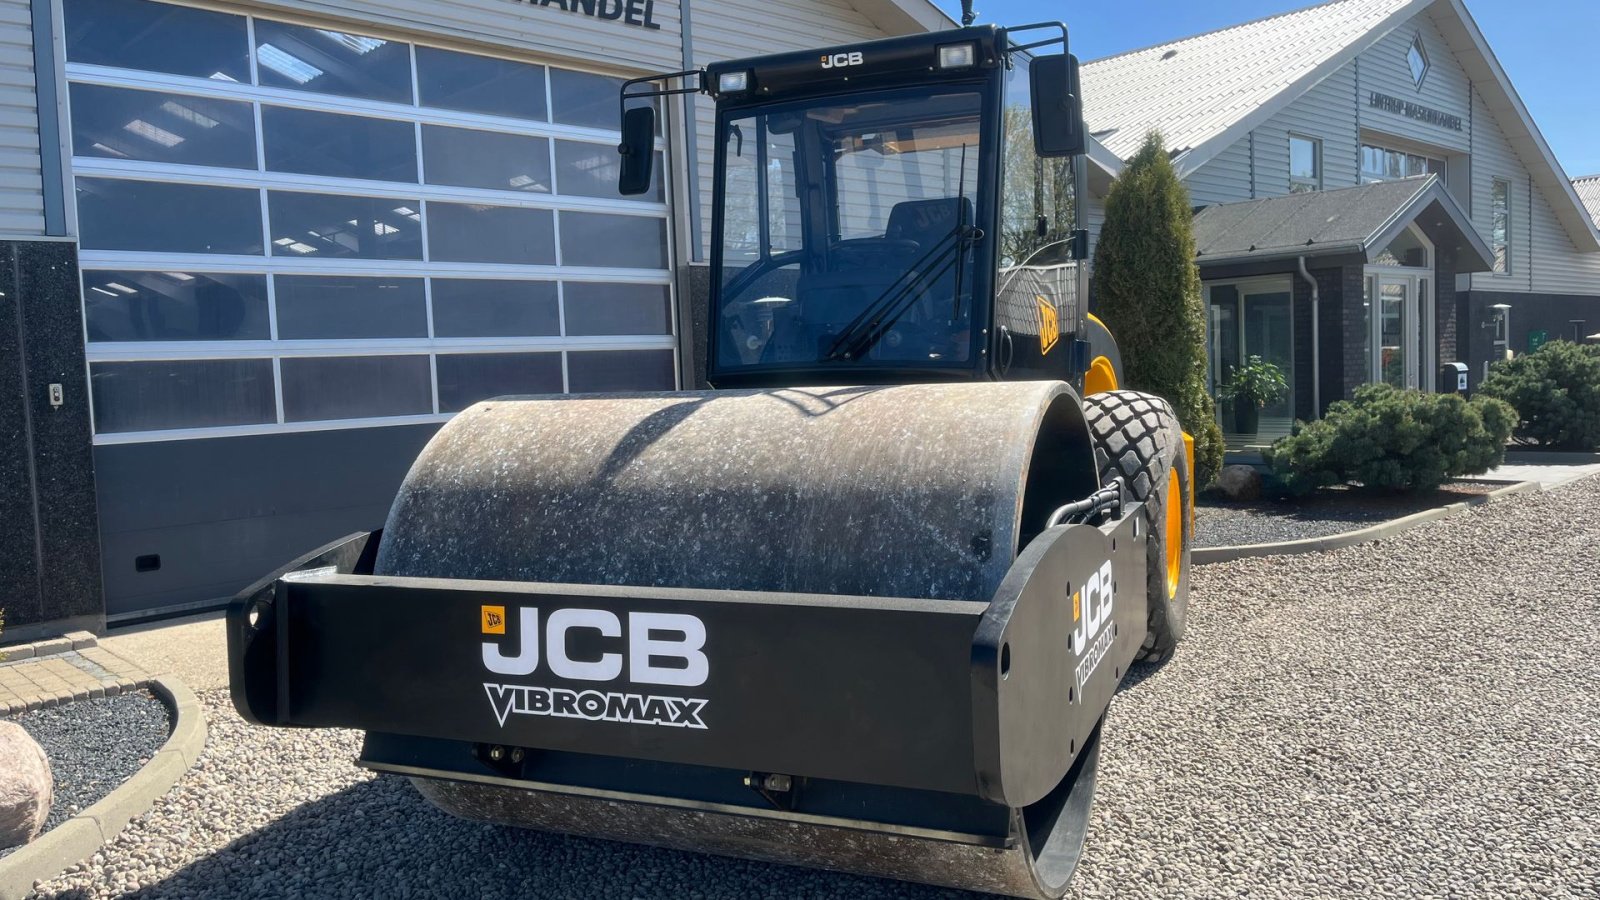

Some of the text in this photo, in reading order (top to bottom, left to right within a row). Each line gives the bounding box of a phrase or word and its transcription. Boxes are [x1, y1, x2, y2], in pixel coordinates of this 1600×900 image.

[517, 0, 660, 30] NDEL
[821, 51, 864, 69] JCB
[916, 205, 951, 228] JCB
[1040, 303, 1057, 348] JCB
[1074, 560, 1113, 656] JCB
[482, 607, 709, 687] JCB
[1075, 620, 1114, 705] VIBROMAX
[483, 683, 709, 729] VIBROMAX
